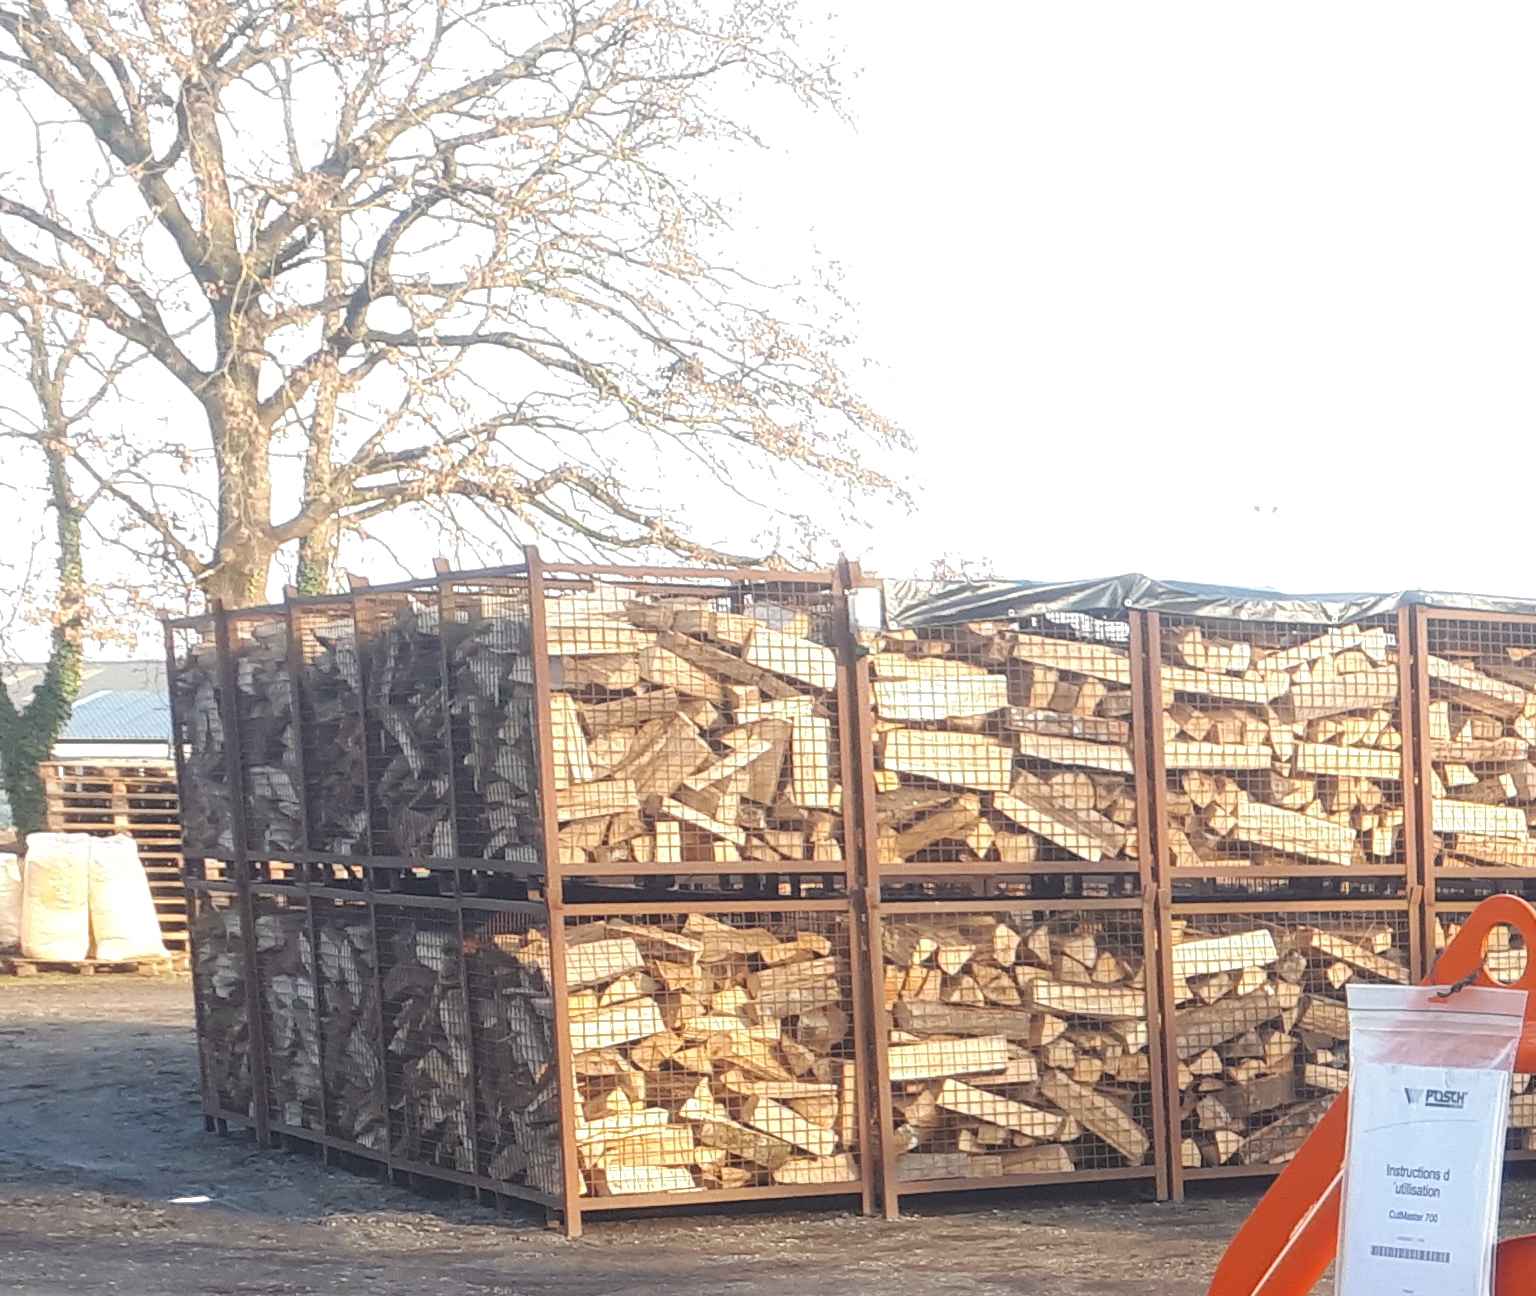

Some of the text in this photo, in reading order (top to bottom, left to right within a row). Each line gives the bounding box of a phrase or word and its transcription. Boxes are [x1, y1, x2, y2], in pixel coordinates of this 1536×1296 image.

[1425, 1089, 1467, 1105] POSCH
[1386, 1164, 1450, 1181] Instructions d
[1424, 1213, 1438, 1223] 700
